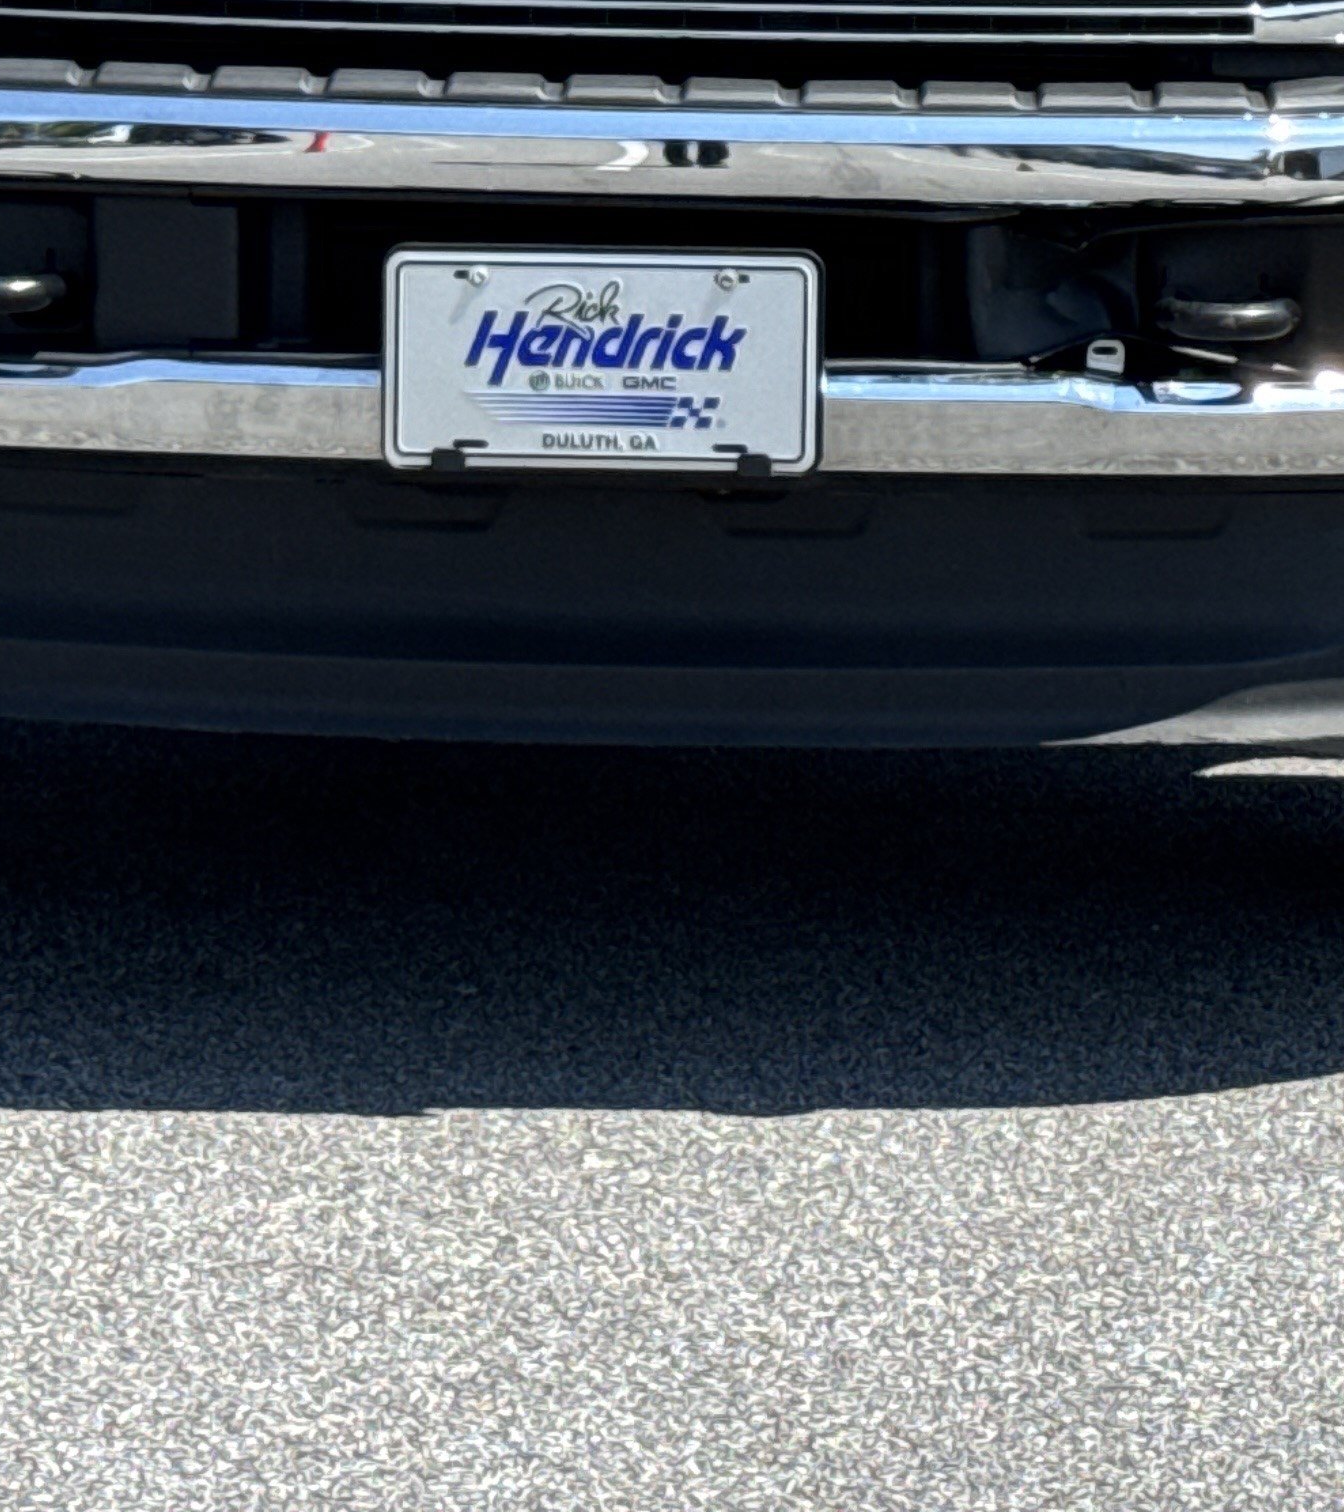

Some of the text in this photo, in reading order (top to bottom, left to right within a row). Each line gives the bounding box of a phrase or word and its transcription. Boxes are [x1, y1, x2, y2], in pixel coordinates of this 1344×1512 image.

[523, 280, 623, 334] Rick
[463, 309, 748, 387] Hendrick
[553, 373, 677, 390] BUICK GMC
[542, 433, 658, 452] DULUTH, GA
